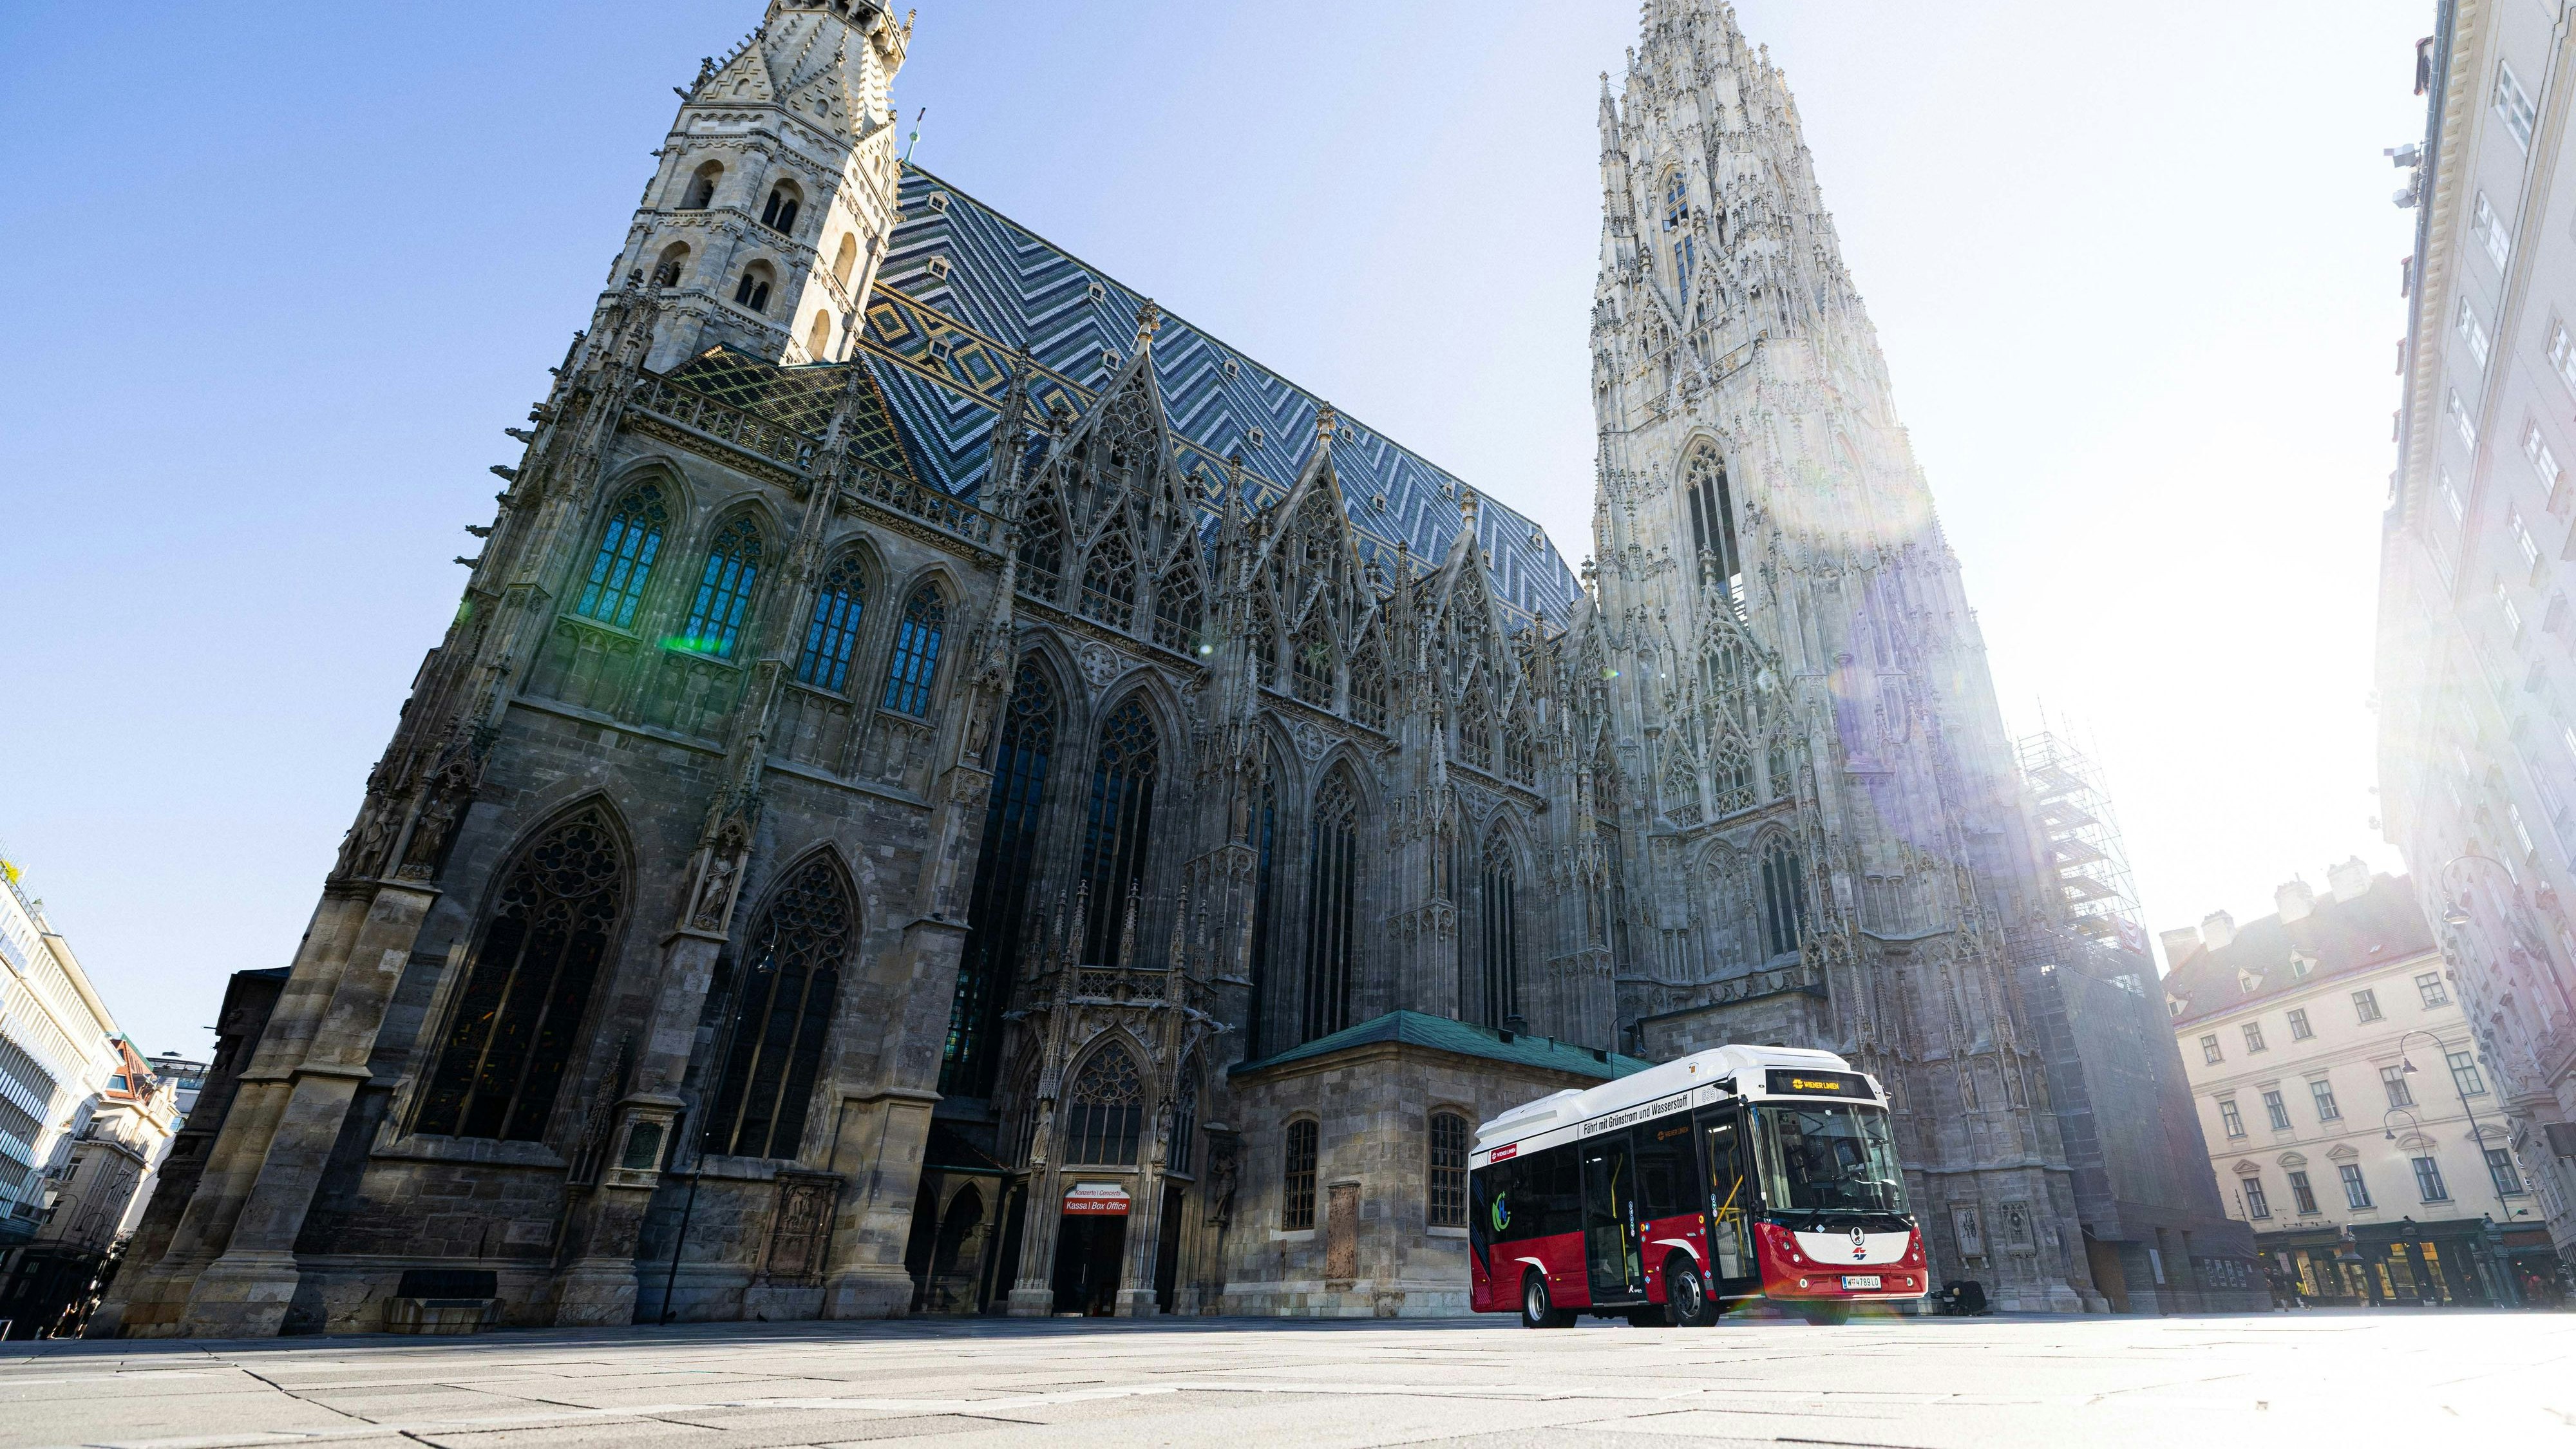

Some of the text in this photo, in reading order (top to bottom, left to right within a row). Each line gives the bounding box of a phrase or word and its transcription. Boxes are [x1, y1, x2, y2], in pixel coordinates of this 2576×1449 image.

[1804, 1081, 1840, 1090] WIENER LINIEN
[1584, 1094, 1687, 1135] Fährt mit Grünstrom und Wasserstoff
[1066, 1201, 1087, 1209] Kassa
[1106, 1202, 1127, 1210] Office
